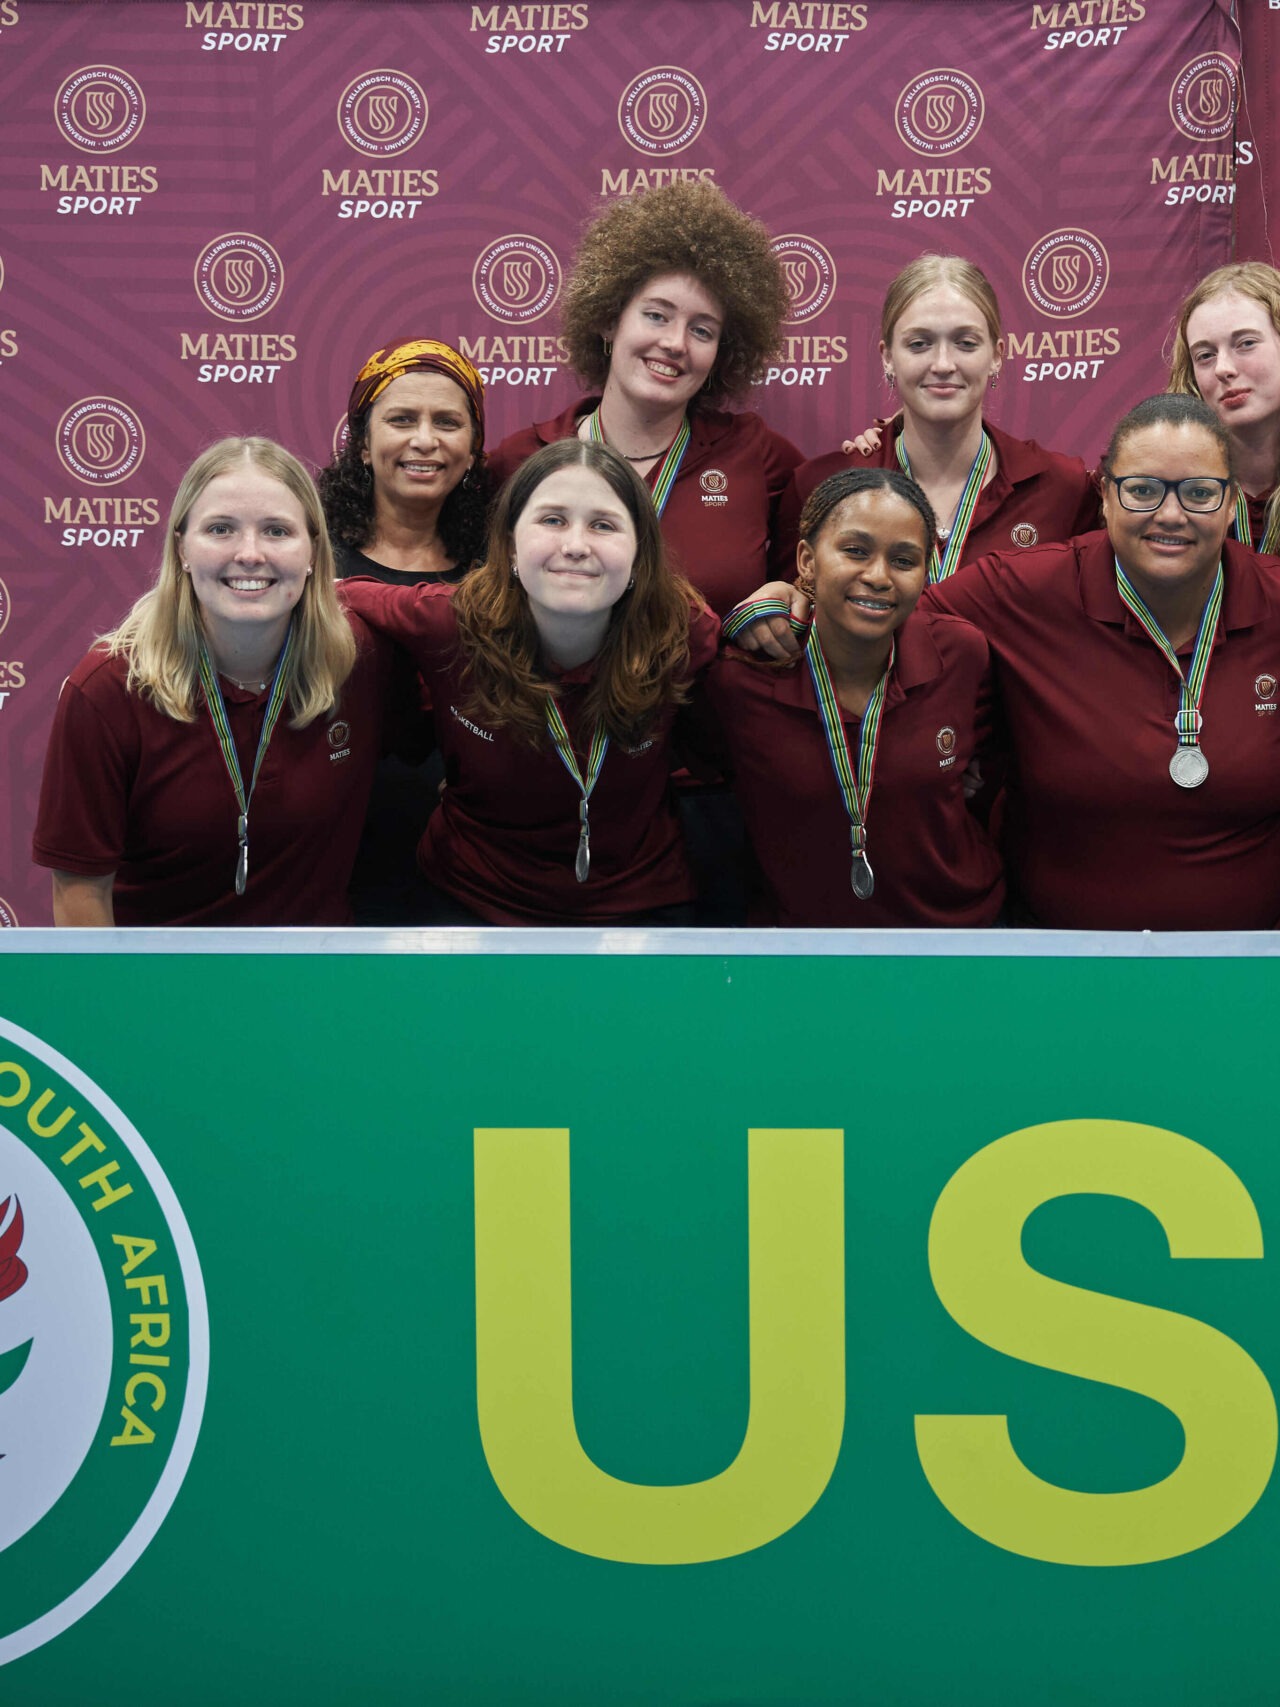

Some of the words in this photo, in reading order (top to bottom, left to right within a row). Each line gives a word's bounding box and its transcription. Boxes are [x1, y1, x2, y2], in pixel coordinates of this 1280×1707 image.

[186, 2, 304, 30] MATIES
[470, 4, 588, 31] MATIES
[750, 1, 867, 30] MATIES
[1031, 0, 1146, 30] MATIES
[201, 33, 286, 51] SPORT
[485, 35, 570, 53] SPORT
[764, 33, 849, 52] SPORT
[1043, 26, 1126, 50] SPORT
[62, 72, 106, 103] STELLENBOSCH
[108, 73, 139, 105] UNIVERSITY
[345, 76, 389, 107] STELLENBOSCH
[390, 77, 421, 109] UNIVERSITY
[626, 73, 669, 105] STELLENBOSCH
[670, 75, 700, 107] UNIVERSITY
[903, 75, 946, 107] STELLENBOSCH
[948, 77, 978, 108] UNIVERSITY
[103, 114, 138, 147] UNIVERSITEIT
[385, 118, 421, 151] UNIVERSITEIT
[665, 116, 700, 149] UNIVERSITEIT
[943, 117, 978, 150] UNIVERSITEIT
[41, 165, 158, 193] MATIES
[322, 170, 439, 196] MATIES
[876, 168, 991, 195] MATIES
[1150, 153, 1235, 184] MATIE
[57, 196, 141, 214] SPORT
[338, 200, 422, 218] SPORT
[891, 199, 974, 218] SPORT
[202, 240, 245, 271] STELLENBOSCH
[247, 241, 277, 273] UNIVERSITY
[480, 242, 523, 273] STELLENBOSCH
[525, 243, 555, 275] UNIVERSITY
[800, 244, 830, 275] UNIVERSITY
[1029, 235, 1072, 267] STELLENBOSCH
[1073, 237, 1103, 269] UNIVERSITY
[242, 282, 277, 315] UNIVERSITEIT
[520, 284, 555, 317] UNIVERSITEIT
[794, 283, 830, 318] UNIVERSITEIT
[1068, 278, 1102, 312] UNIVERSITEIT
[181, 333, 297, 361] MATIES
[458, 336, 571, 363] MATIES
[782, 335, 848, 363] TIES
[1007, 328, 1120, 359] MATIES
[198, 365, 280, 383] SPORT
[477, 367, 557, 385] SPORT
[764, 367, 831, 386] PORT
[1023, 360, 1104, 381] SPORT
[63, 404, 107, 435] STELLENBOSCH
[109, 405, 139, 436] UNIVERSITY
[104, 446, 139, 479] UNIVERSITEIT
[44, 497, 160, 525] MATIES
[61, 528, 144, 547] SPORT
[110, 1233, 172, 1448] AFRICA
